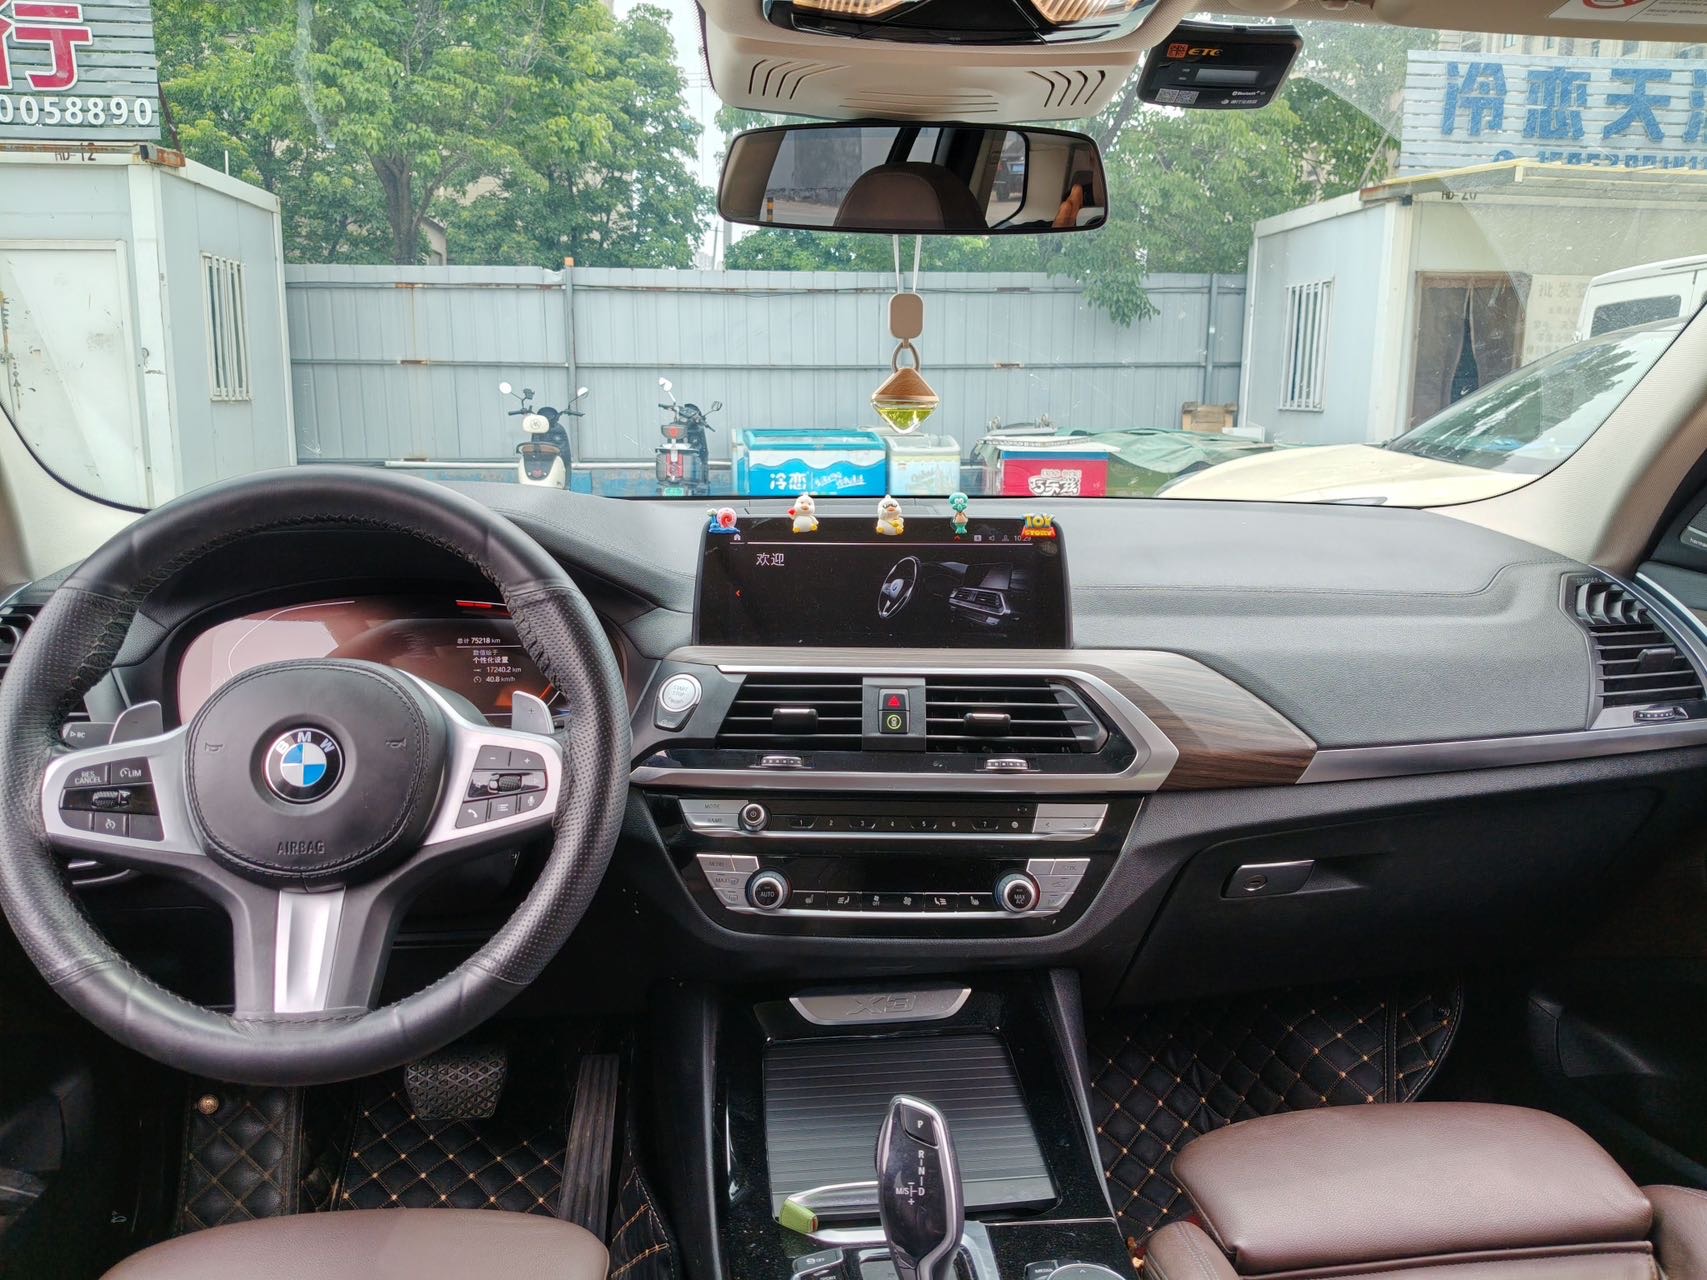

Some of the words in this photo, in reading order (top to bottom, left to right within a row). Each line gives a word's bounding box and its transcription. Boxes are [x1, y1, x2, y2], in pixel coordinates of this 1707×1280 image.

[1187, 47, 1223, 57] ETC
[1440, 61, 1707, 144] 冷恋天
[0, 94, 153, 126] 0058890
[769, 472, 807, 491] 冷恋
[1022, 513, 1055, 528] TOY
[1024, 528, 1053, 537] STORY
[755, 552, 785, 567] 欢迎
[275, 731, 336, 755] BMW
[81, 770, 96, 778] RES
[128, 769, 142, 777] LIM
[74, 776, 102, 785] CANCEL
[277, 841, 326, 856] AIRBAG
[917, 1120, 924, 1129] P
[917, 1150, 925, 1159] R
[917, 1166, 926, 1175] N
[917, 1187, 926, 1196] D
